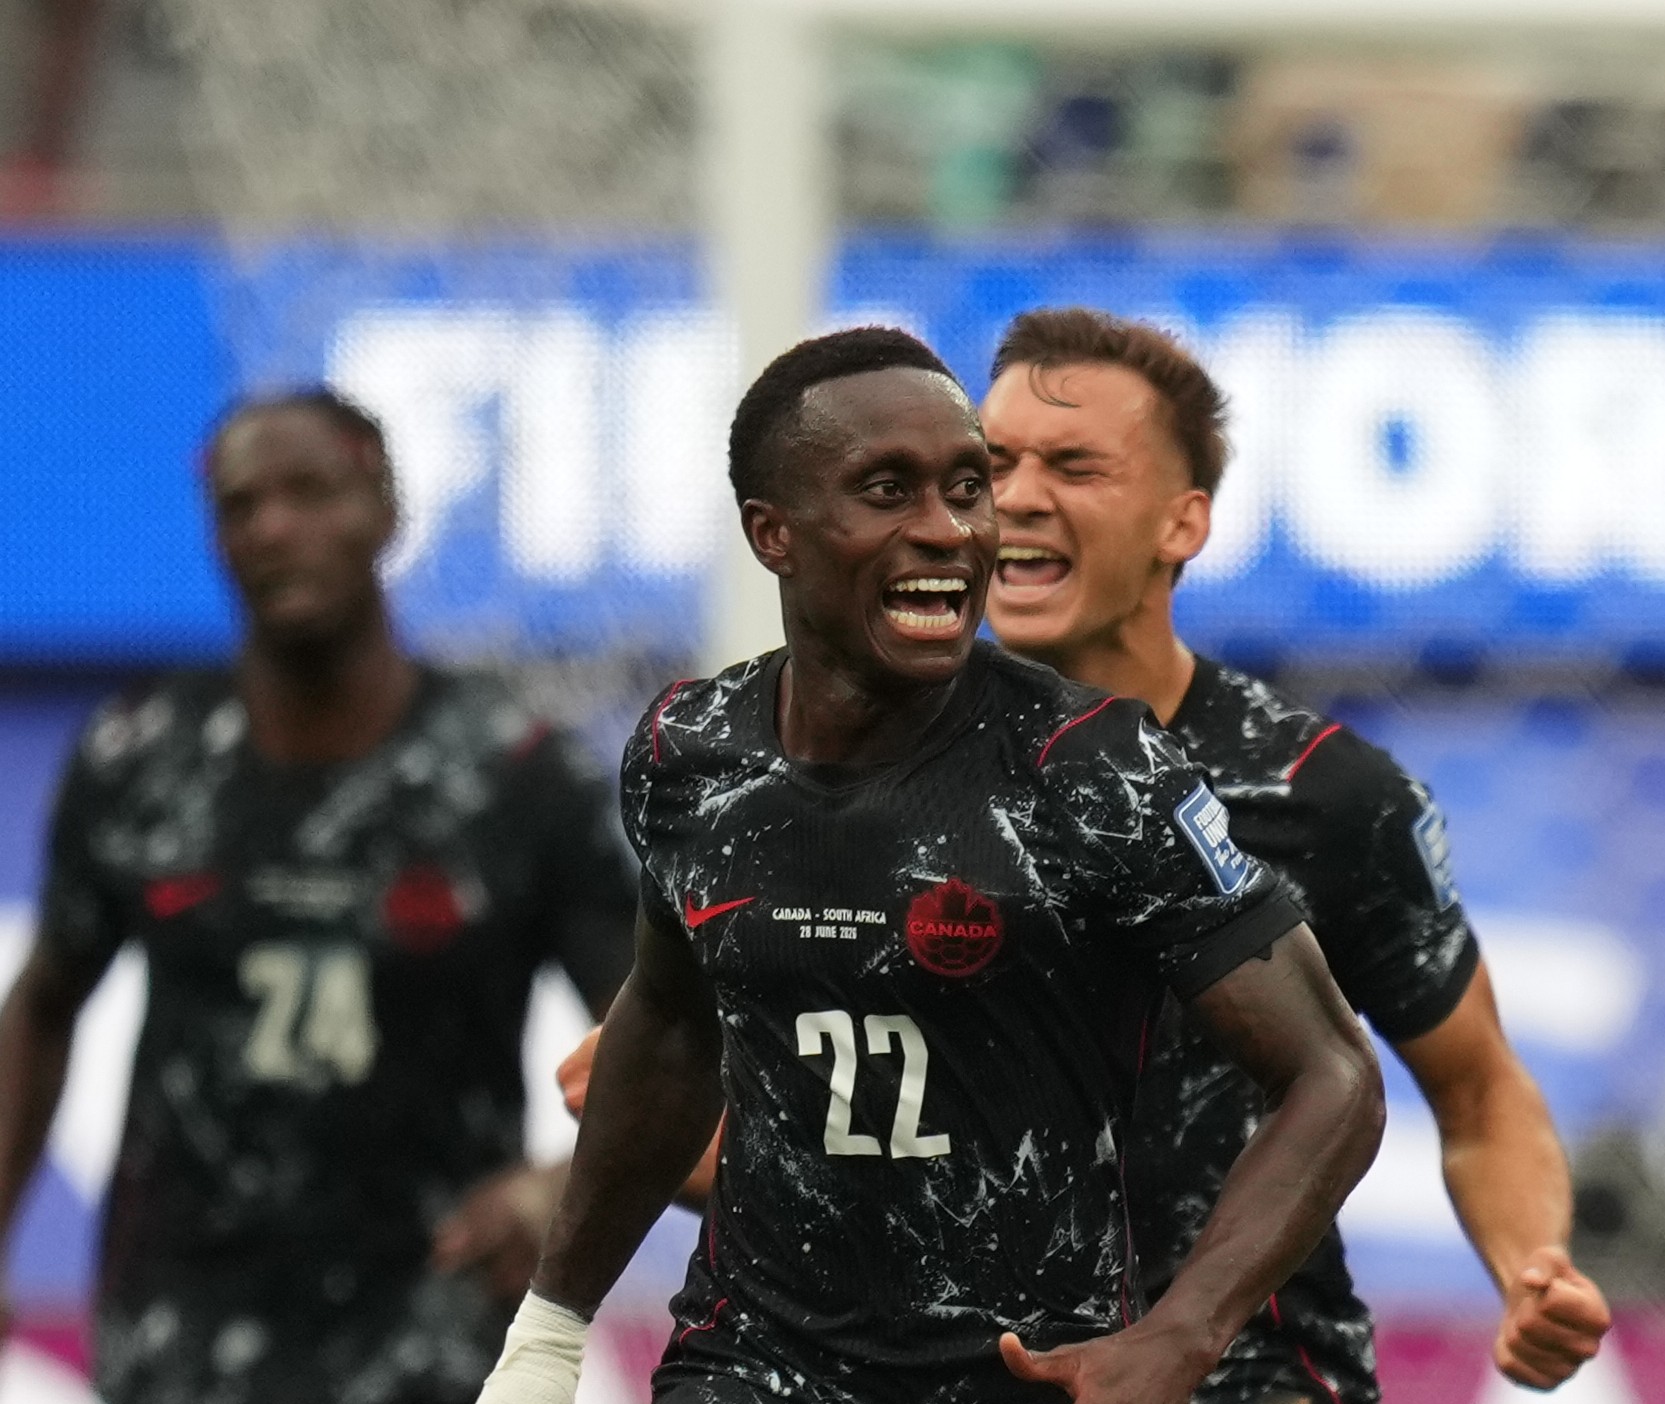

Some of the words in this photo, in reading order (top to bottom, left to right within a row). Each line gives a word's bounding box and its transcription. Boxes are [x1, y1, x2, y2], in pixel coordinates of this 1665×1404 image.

[772, 907, 812, 920] CANADA
[823, 908, 853, 921] SOUTH
[855, 910, 887, 925] AFRICA
[800, 925, 812, 938] 28
[815, 925, 837, 938] JUNE
[840, 926, 857, 940] 2026
[909, 920, 997, 938] CANADA
[236, 941, 379, 1087] 24
[796, 1009, 951, 1159] 22
